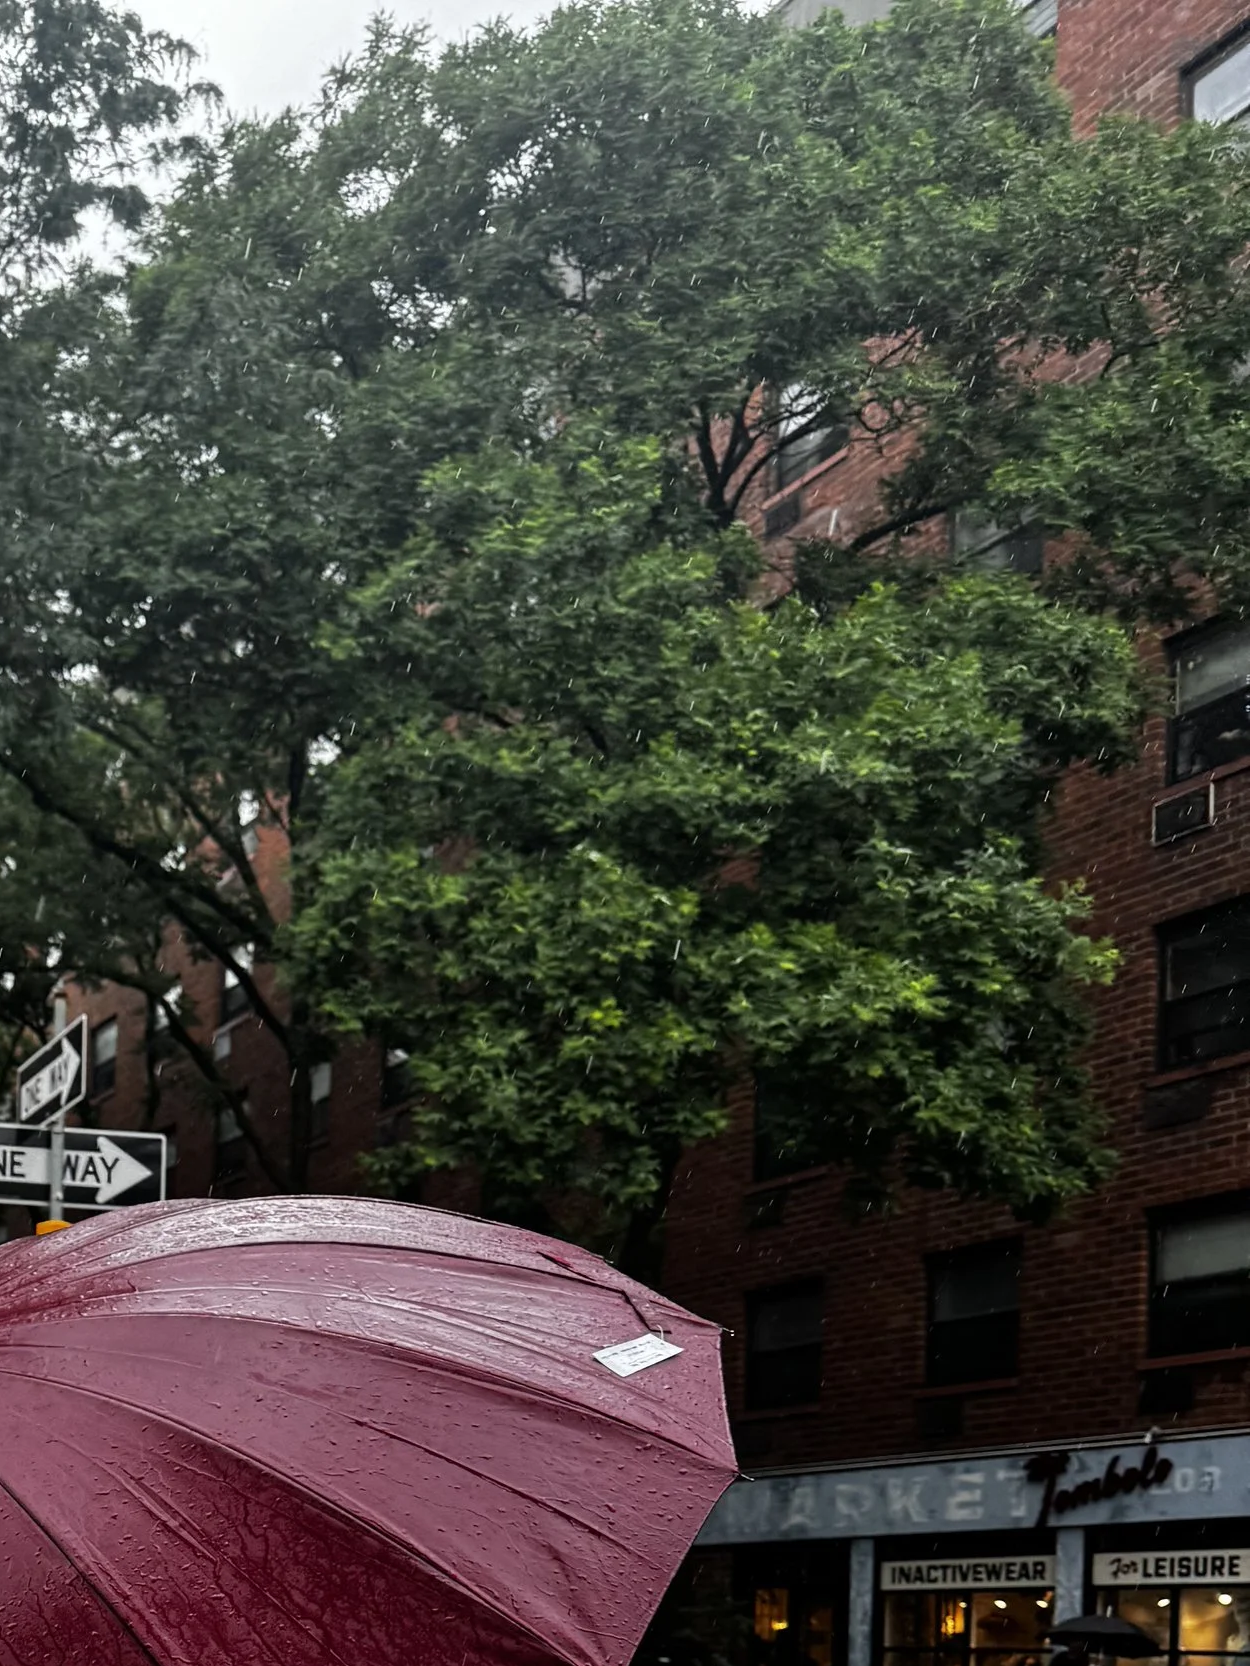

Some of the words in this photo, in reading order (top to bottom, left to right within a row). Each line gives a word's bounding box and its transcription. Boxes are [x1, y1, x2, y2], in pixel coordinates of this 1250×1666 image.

[63, 1153, 119, 1184] WAY
[890, 1560, 1046, 1585] INACTIVEWEAR
[1108, 1557, 1138, 1580] For
[1141, 1555, 1241, 1579] LEISURE
